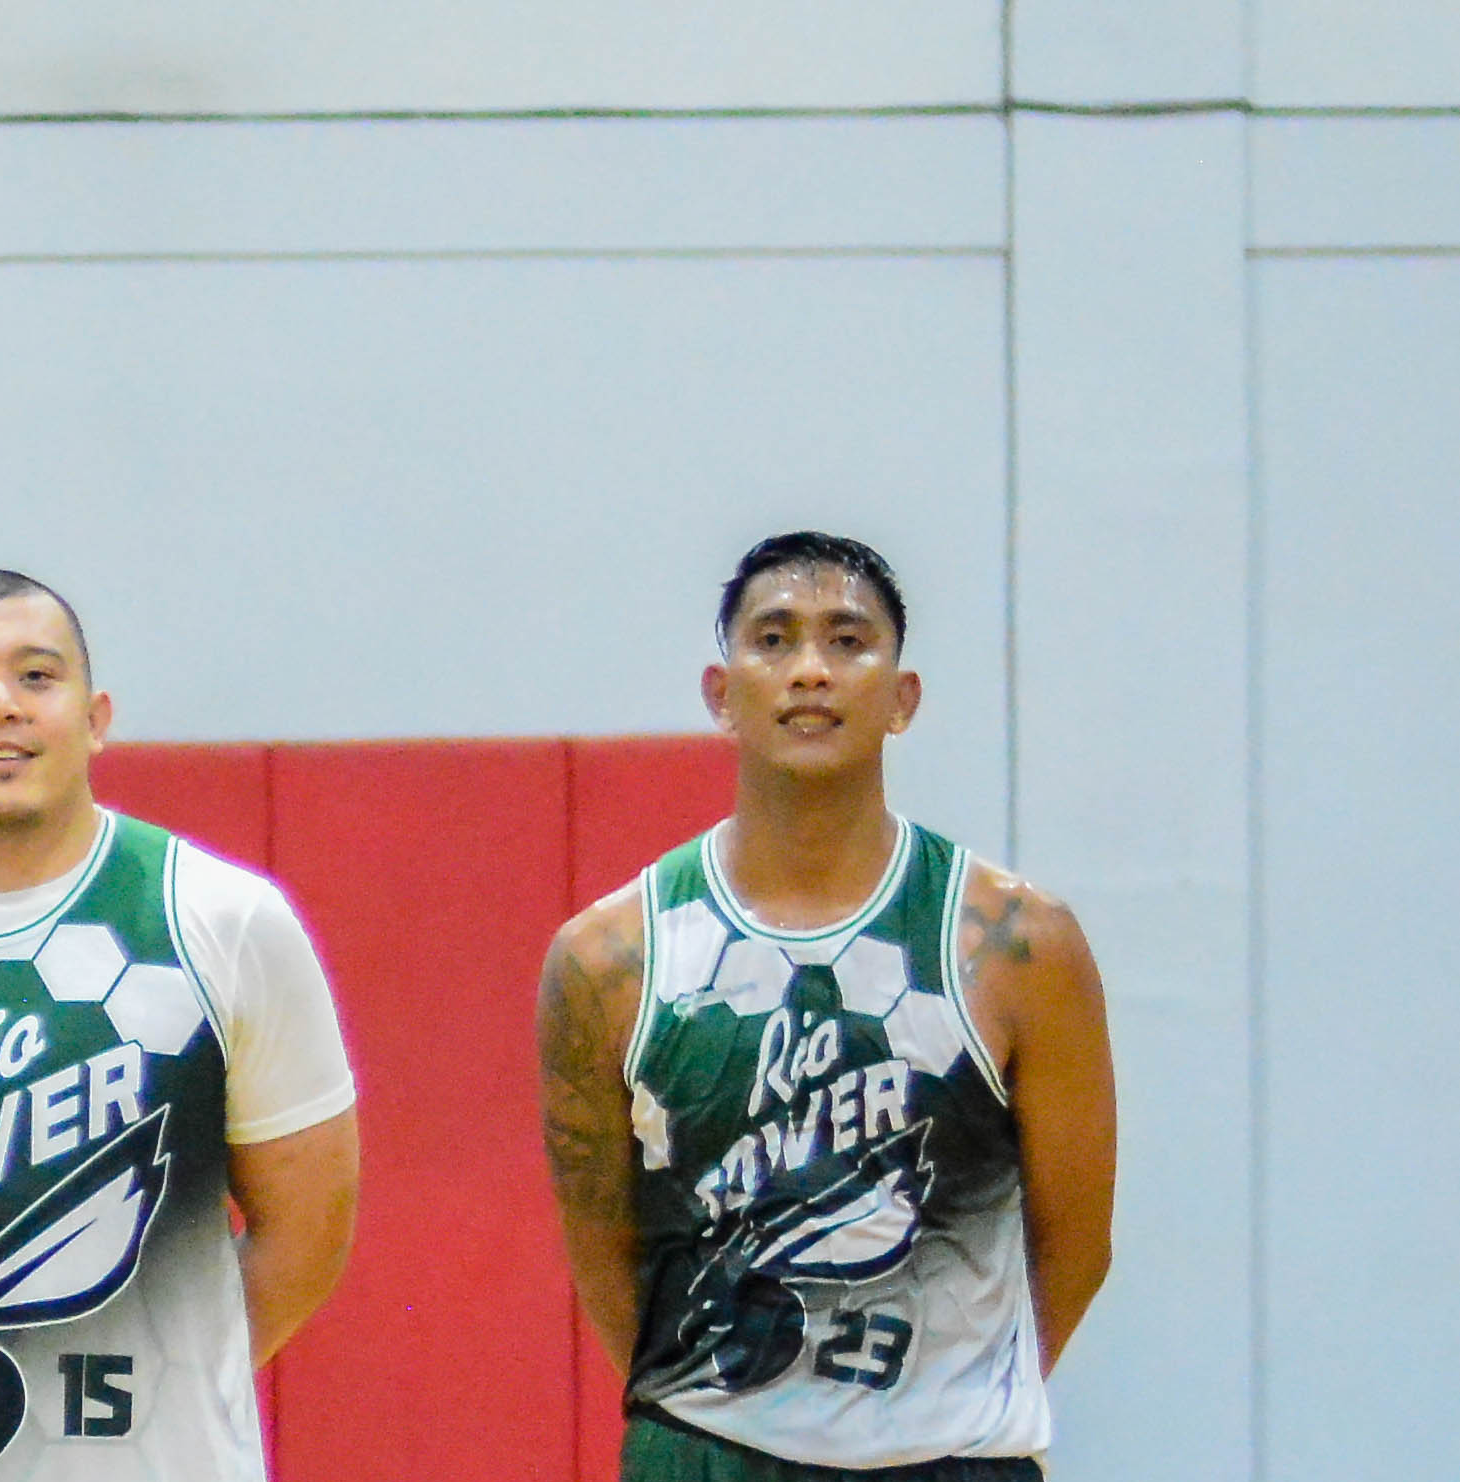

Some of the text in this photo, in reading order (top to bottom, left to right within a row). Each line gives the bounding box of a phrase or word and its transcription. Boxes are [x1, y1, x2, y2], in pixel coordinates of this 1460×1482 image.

[748, 1007, 839, 1117] Rio
[814, 1310, 914, 1390] 23
[58, 1353, 133, 1438] 15
